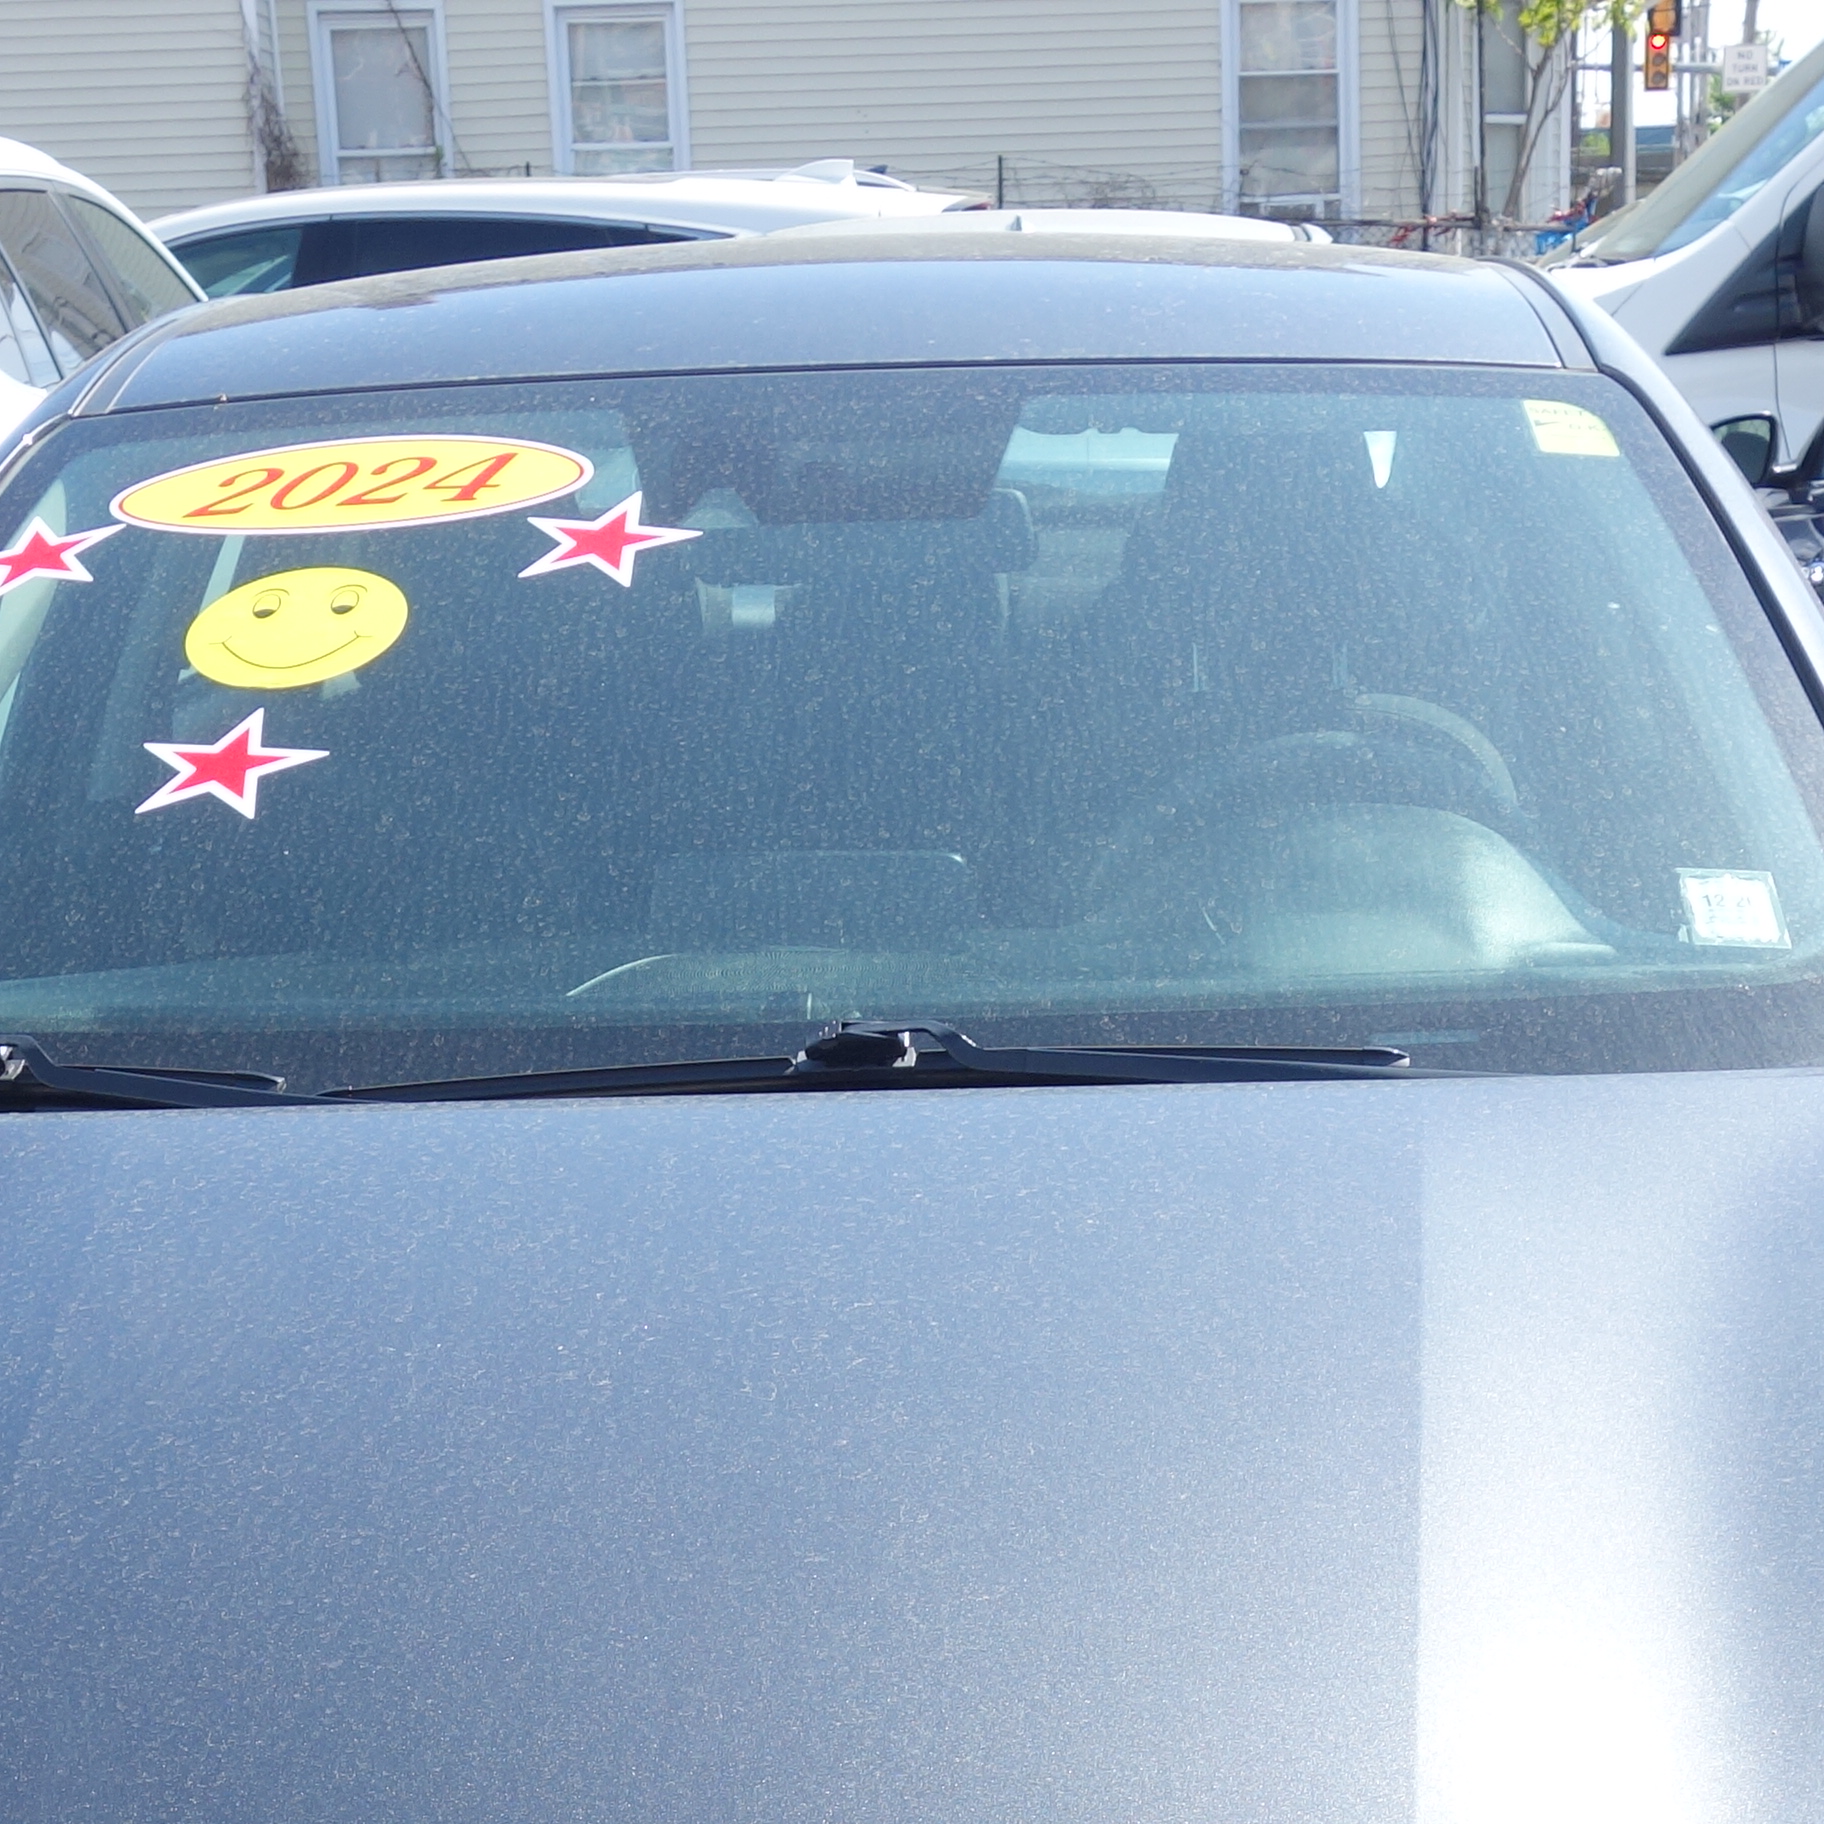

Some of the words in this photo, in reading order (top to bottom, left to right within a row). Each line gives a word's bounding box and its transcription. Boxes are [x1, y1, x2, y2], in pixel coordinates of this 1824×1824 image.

[1737, 50, 1753, 60] NO
[1727, 77, 1740, 86] ON
[1744, 76, 1764, 86] RED
[182, 452, 518, 518] 2024
